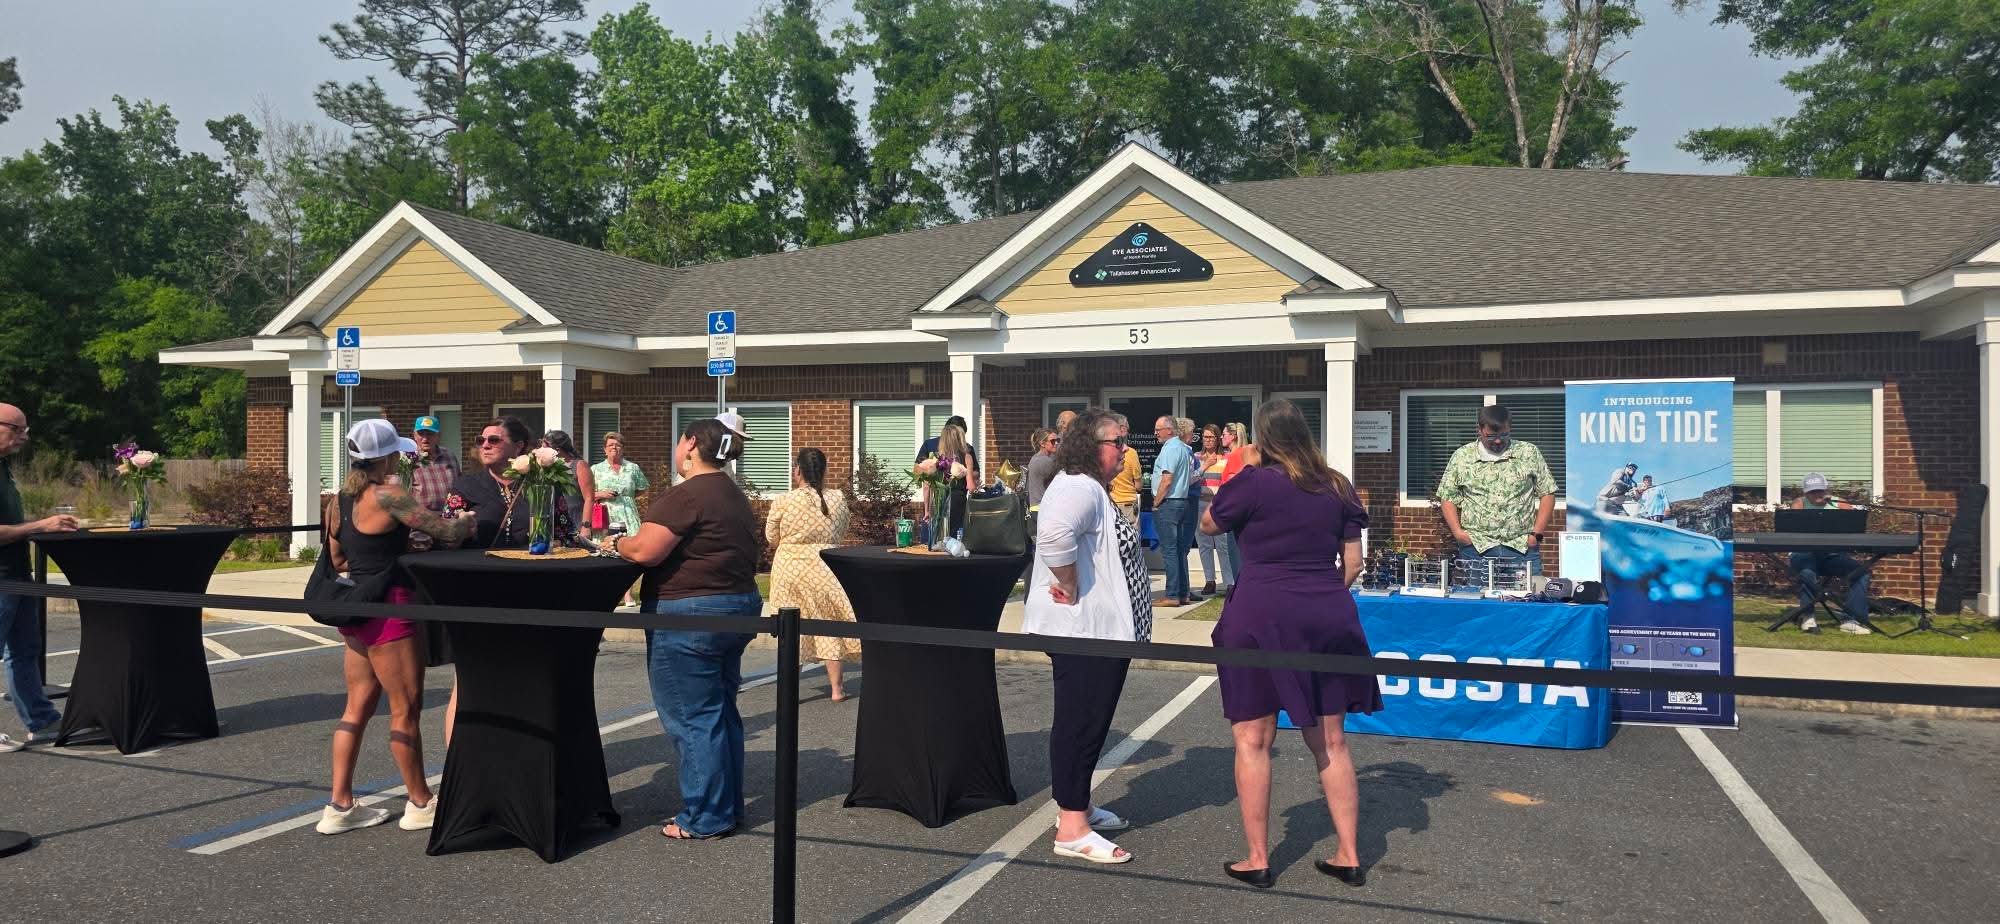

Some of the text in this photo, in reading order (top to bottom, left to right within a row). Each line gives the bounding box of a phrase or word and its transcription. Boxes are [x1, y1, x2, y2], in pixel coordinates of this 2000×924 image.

[1112, 246, 1168, 256] EYE ASSOCIATES
[1129, 328, 1149, 344] 53
[1603, 396, 1694, 406] INTRODUCING
[1580, 410, 1719, 443] KING TIDE
[1375, 651, 1590, 708] COSTA
